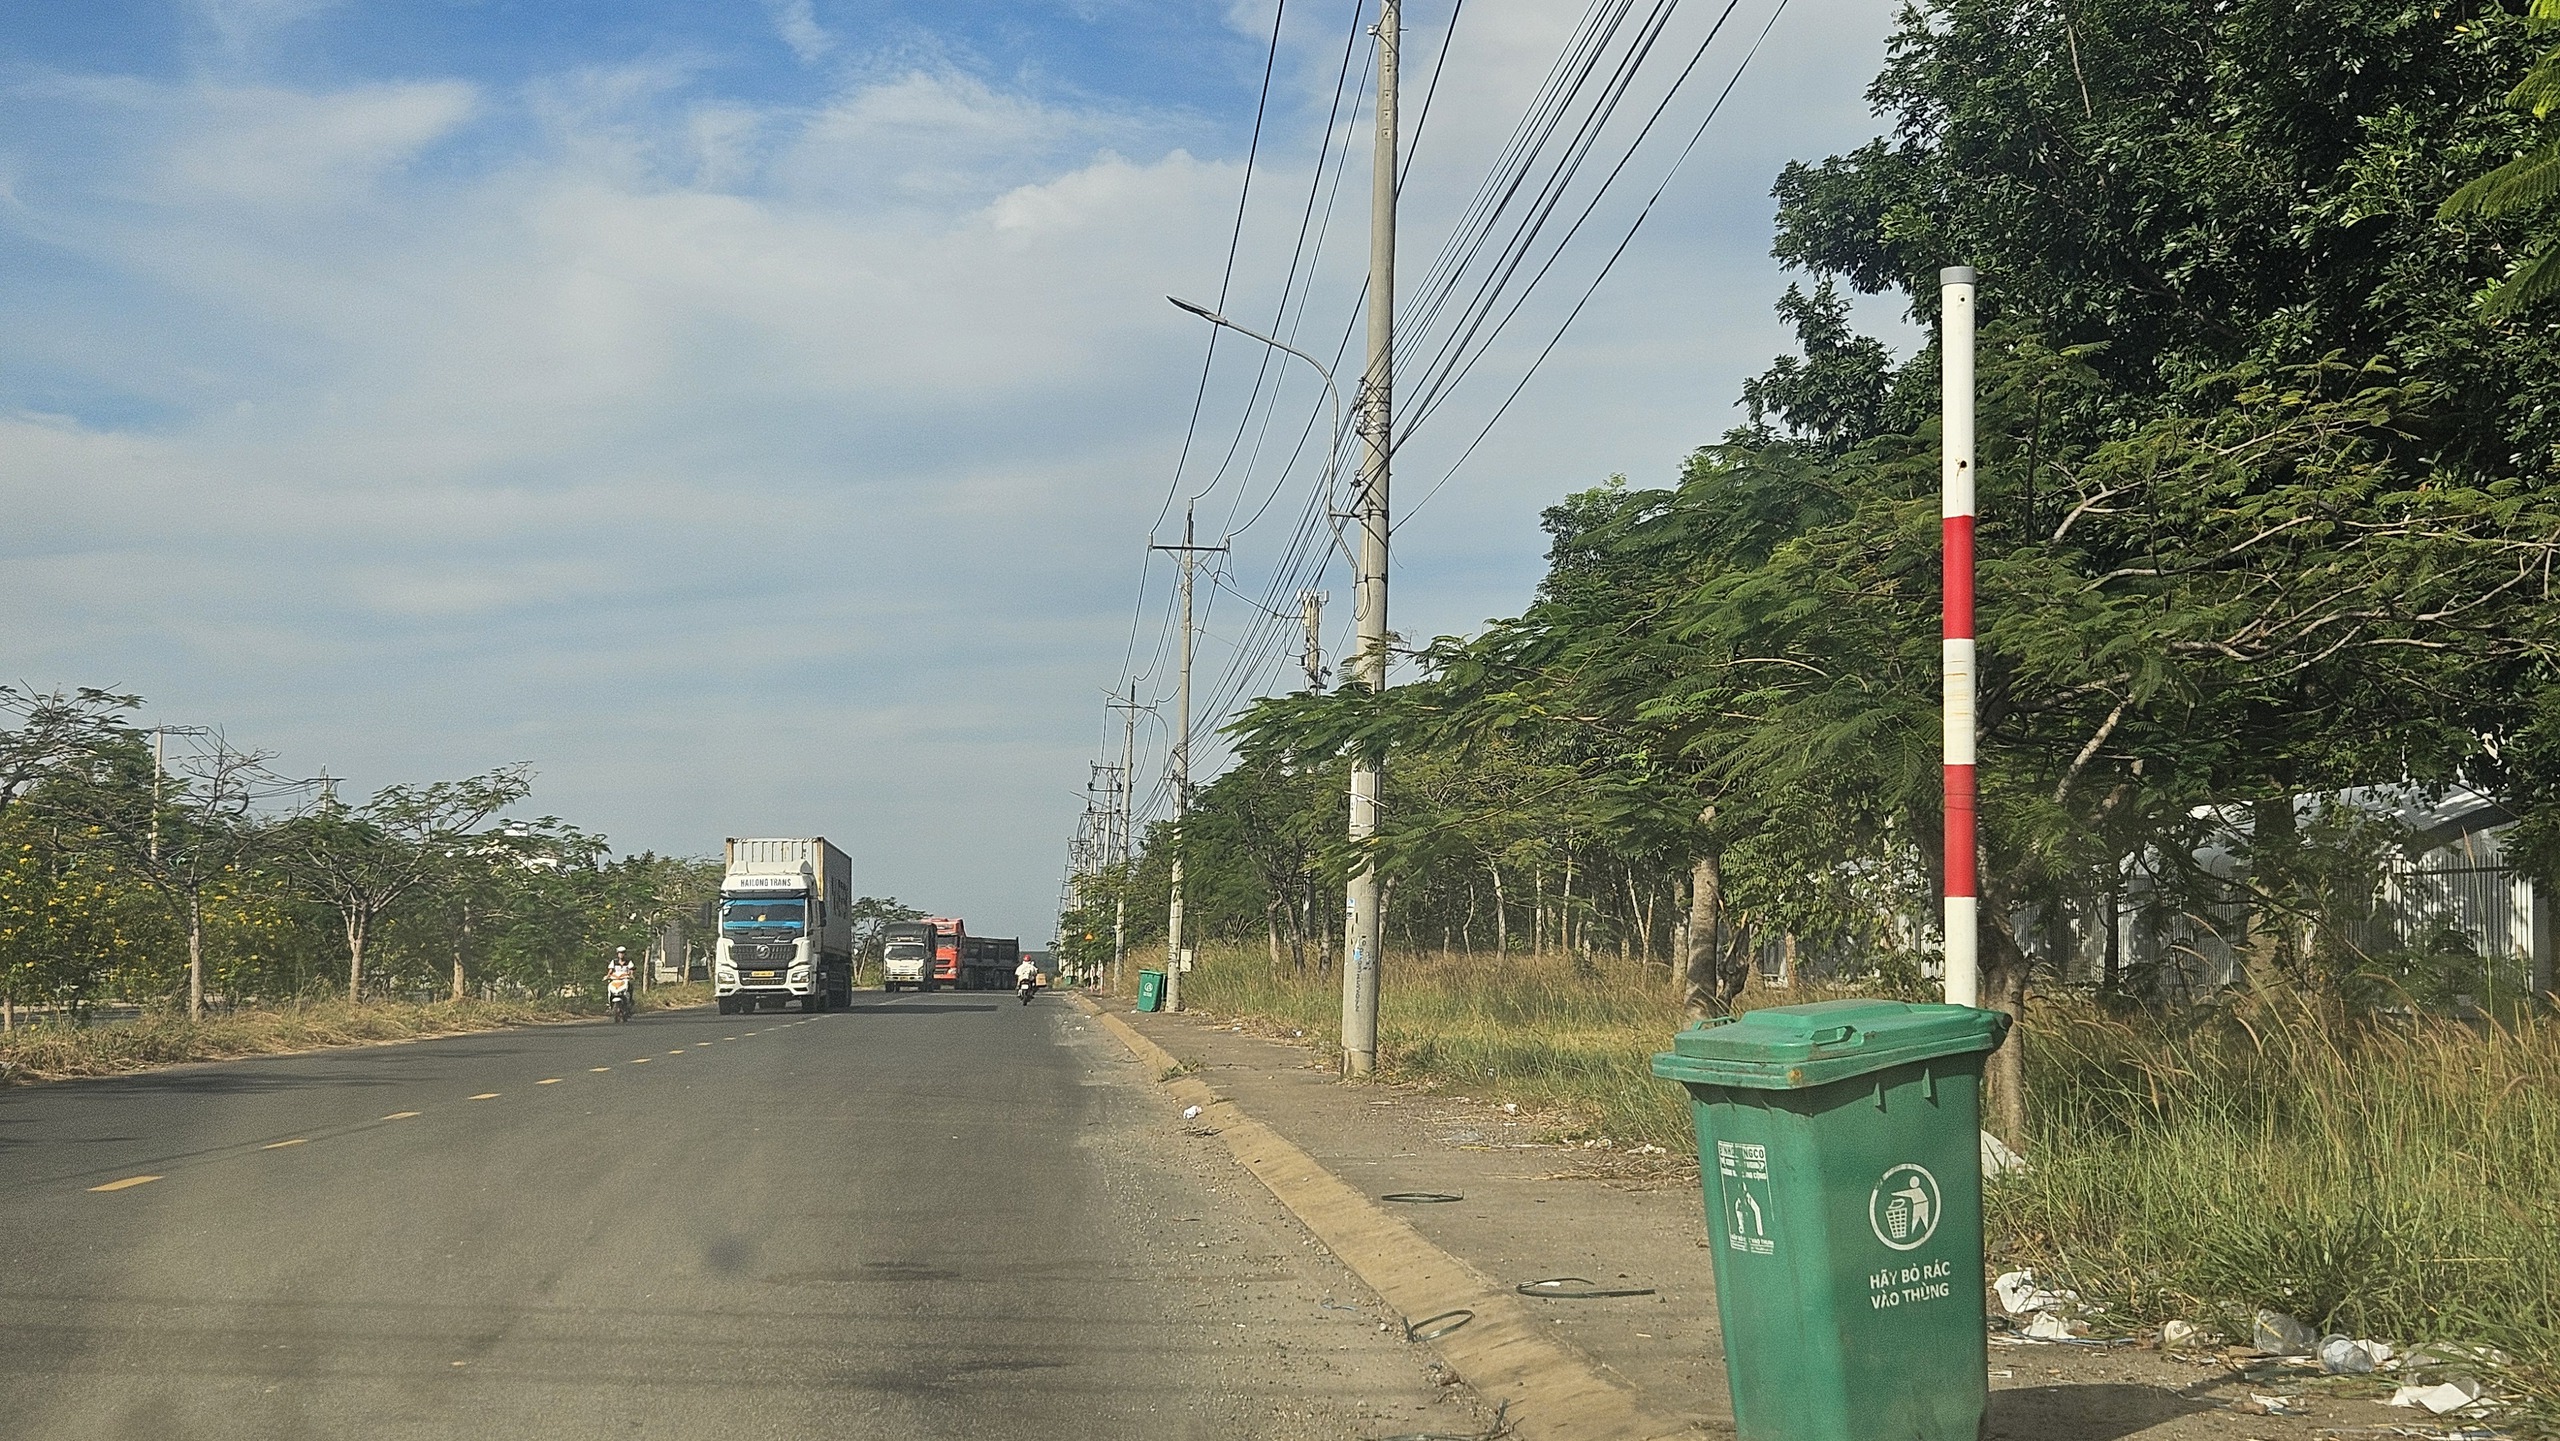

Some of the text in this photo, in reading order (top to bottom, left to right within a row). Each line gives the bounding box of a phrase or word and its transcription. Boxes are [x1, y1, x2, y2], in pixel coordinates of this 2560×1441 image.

[740, 878, 792, 887] HAILONG TRANS
[1869, 1268, 1898, 1290] HÃY
[1923, 1258, 1951, 1280] RÁC
[1870, 1281, 1950, 1310] VÀO THÙNG
